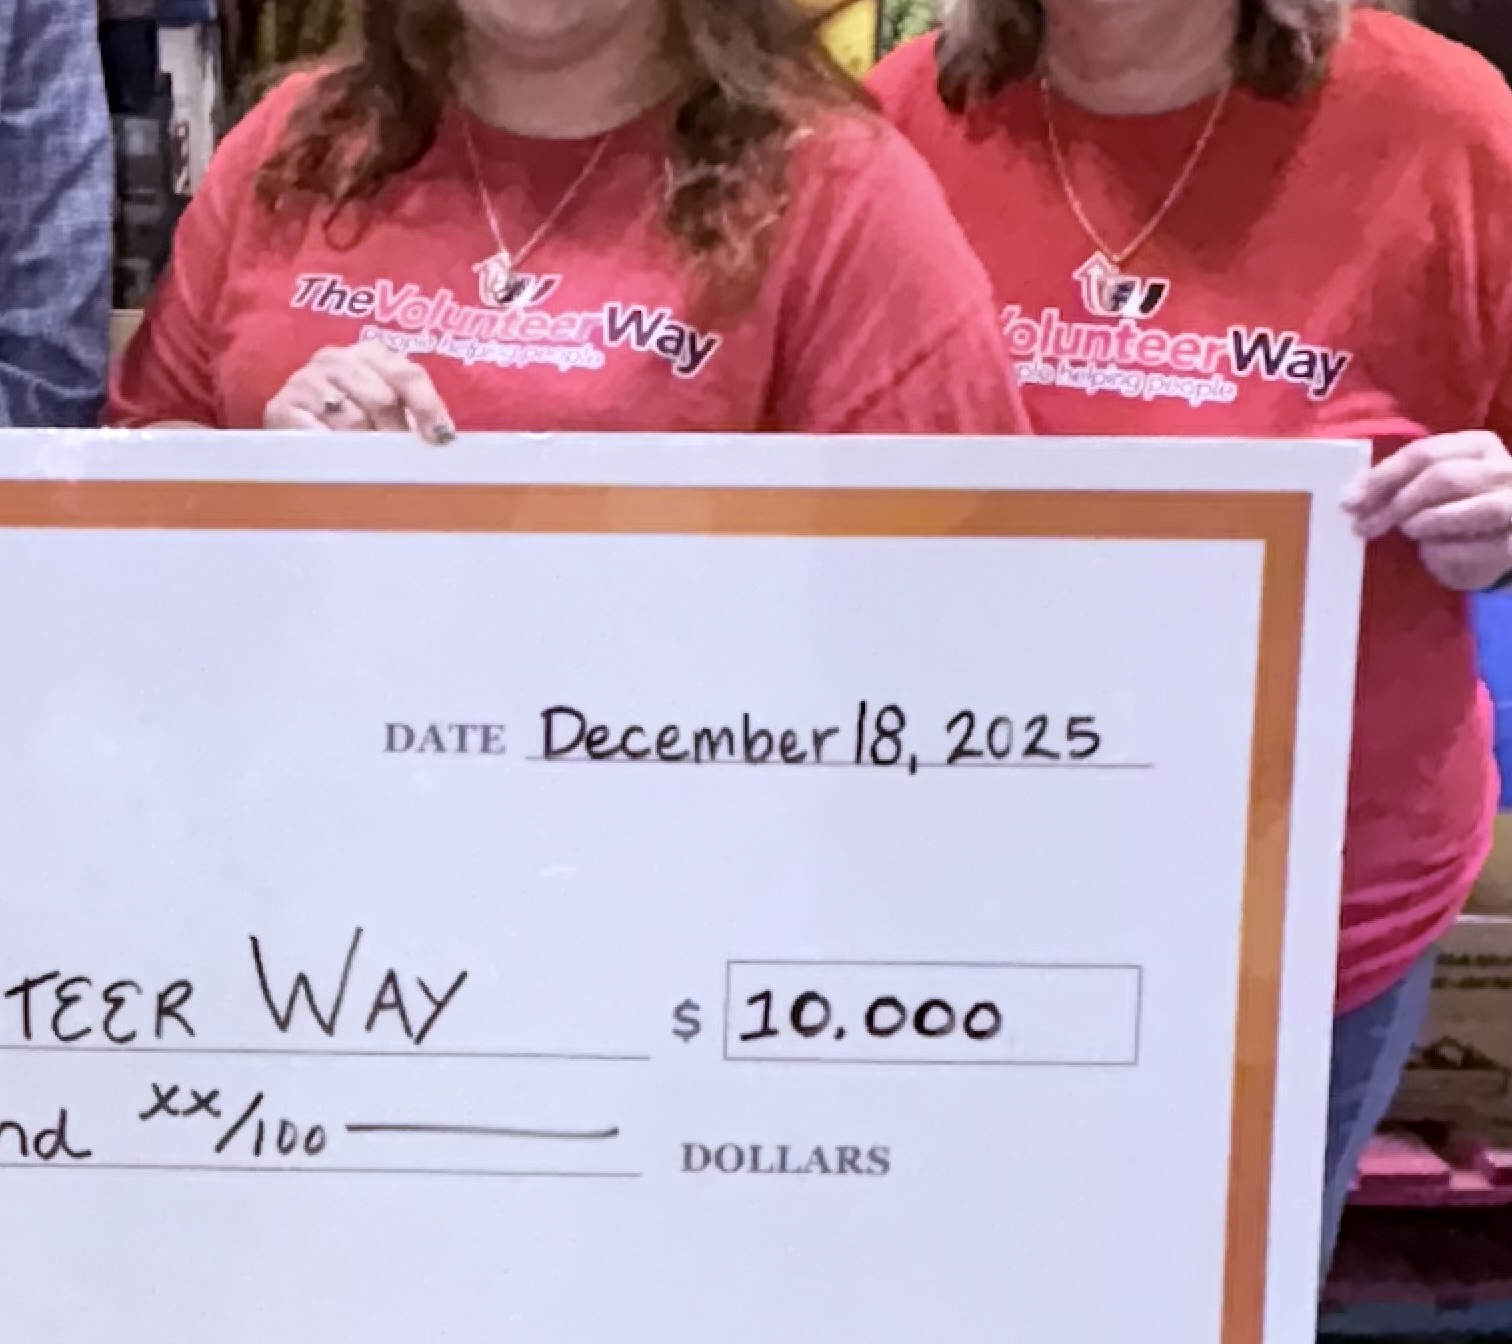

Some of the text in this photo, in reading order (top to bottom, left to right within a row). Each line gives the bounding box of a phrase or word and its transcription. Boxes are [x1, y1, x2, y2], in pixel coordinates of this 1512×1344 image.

[384, 722, 506, 754] DATE
[944, 708, 1102, 760] 2025
[248, 926, 468, 1045] WAY
[672, 998, 702, 1044] $
[682, 1142, 890, 1176] DOLLARS
